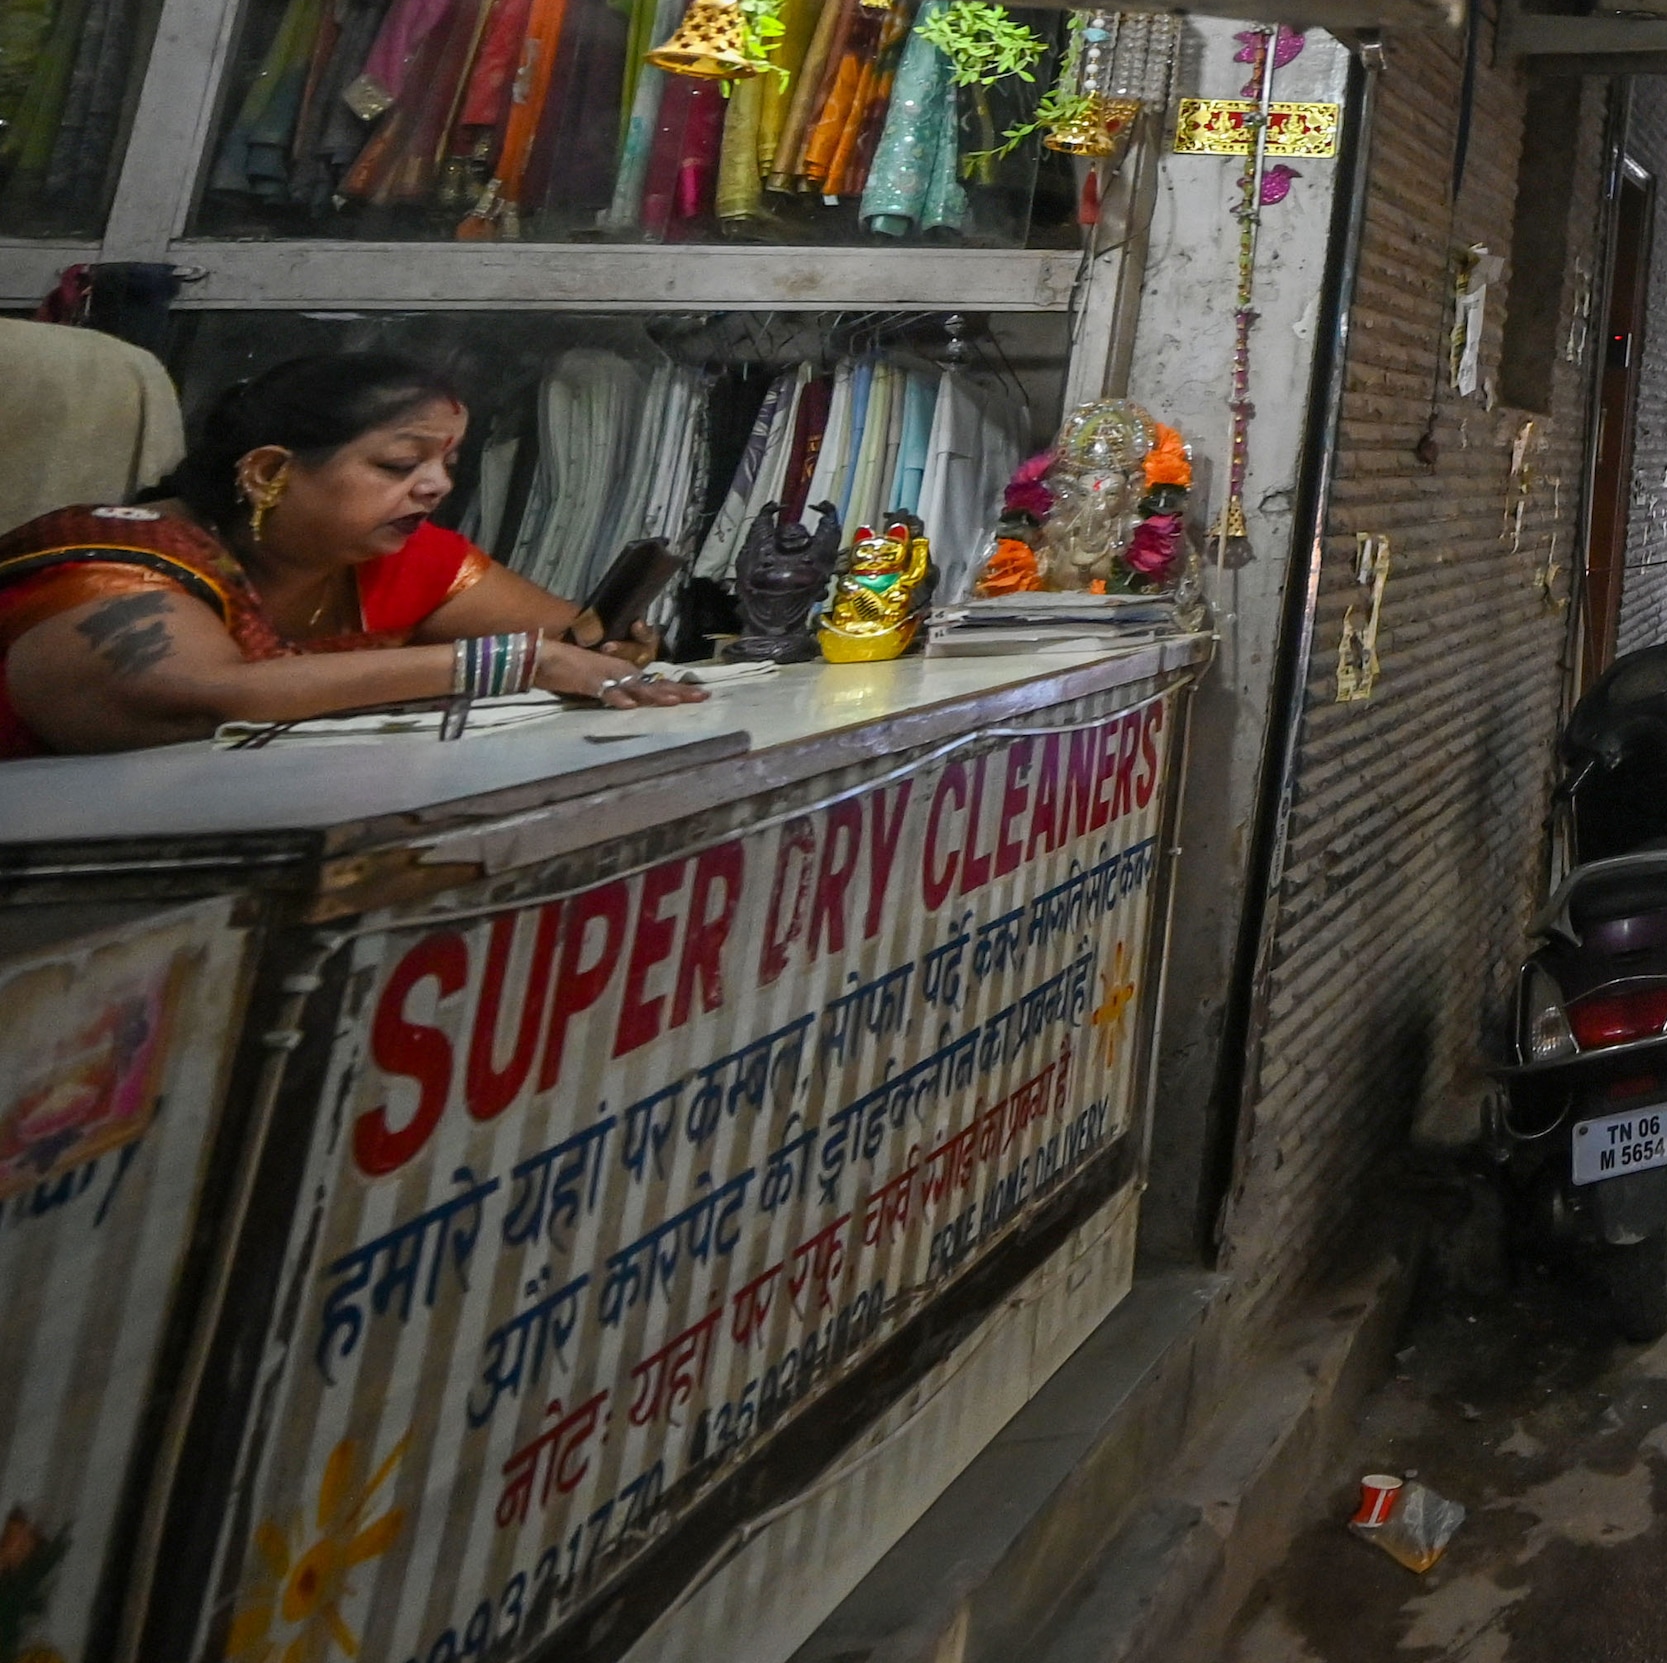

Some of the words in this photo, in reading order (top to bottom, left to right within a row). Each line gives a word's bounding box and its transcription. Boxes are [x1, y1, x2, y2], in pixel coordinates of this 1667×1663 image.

[352, 838, 744, 1178] SUPER
[757, 778, 913, 987] DRY
[922, 699, 1162, 912] CLEANERS
[600, 1168, 755, 1329] कारपेट
[760, 1112, 818, 1213] की
[1600, 1150, 1615, 1171] M
[1620, 1138, 1665, 1167] 5654
[1608, 1122, 1632, 1145] TN
[1634, 1116, 1661, 1139] 06
[316, 1166, 499, 1385] हमारे
[502, 1101, 617, 1254] यहां
[621, 1079, 688, 1184] पर
[630, 1289, 722, 1427] यहां
[731, 1261, 785, 1349] पर
